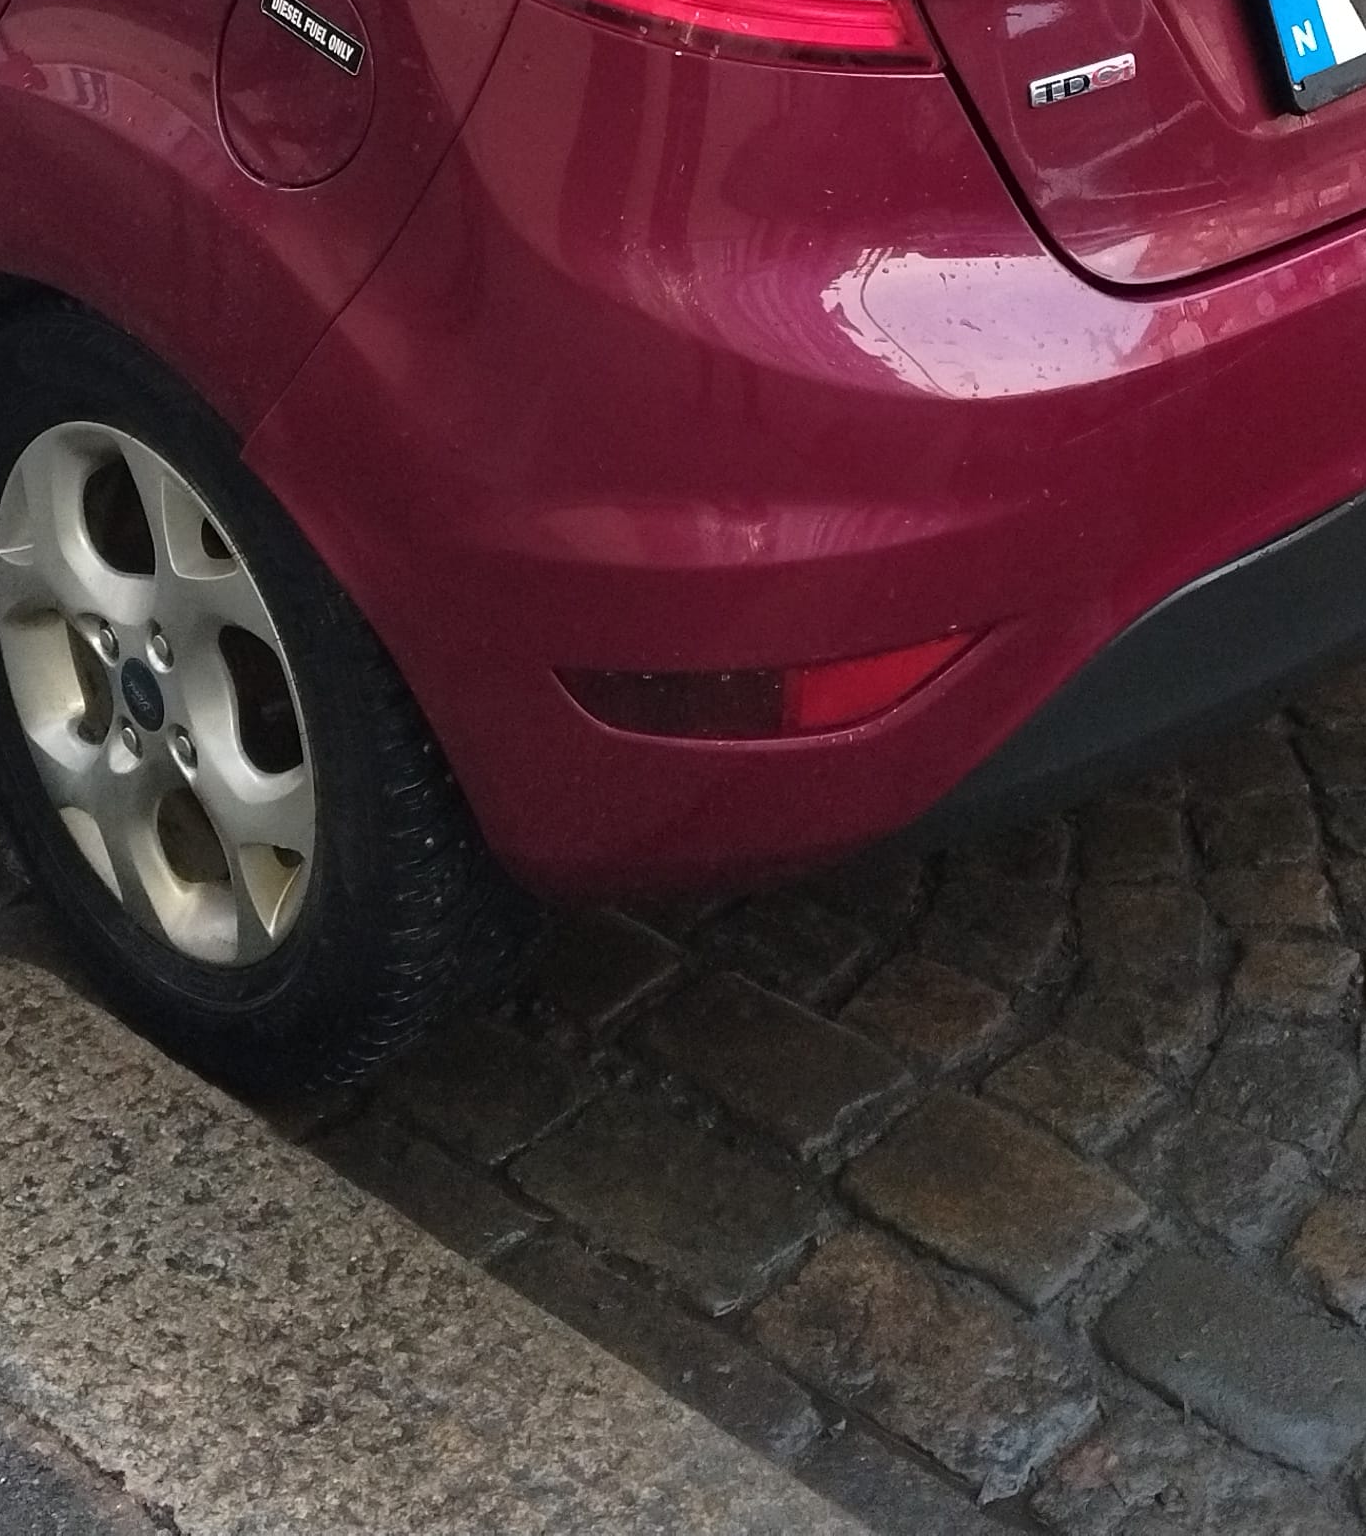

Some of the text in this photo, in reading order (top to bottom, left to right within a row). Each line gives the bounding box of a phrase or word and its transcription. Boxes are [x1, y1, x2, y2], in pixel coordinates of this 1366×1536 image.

[303, 16, 327, 45] FUEL
[328, 34, 355, 62] ONLY
[1291, 20, 1318, 57] N
